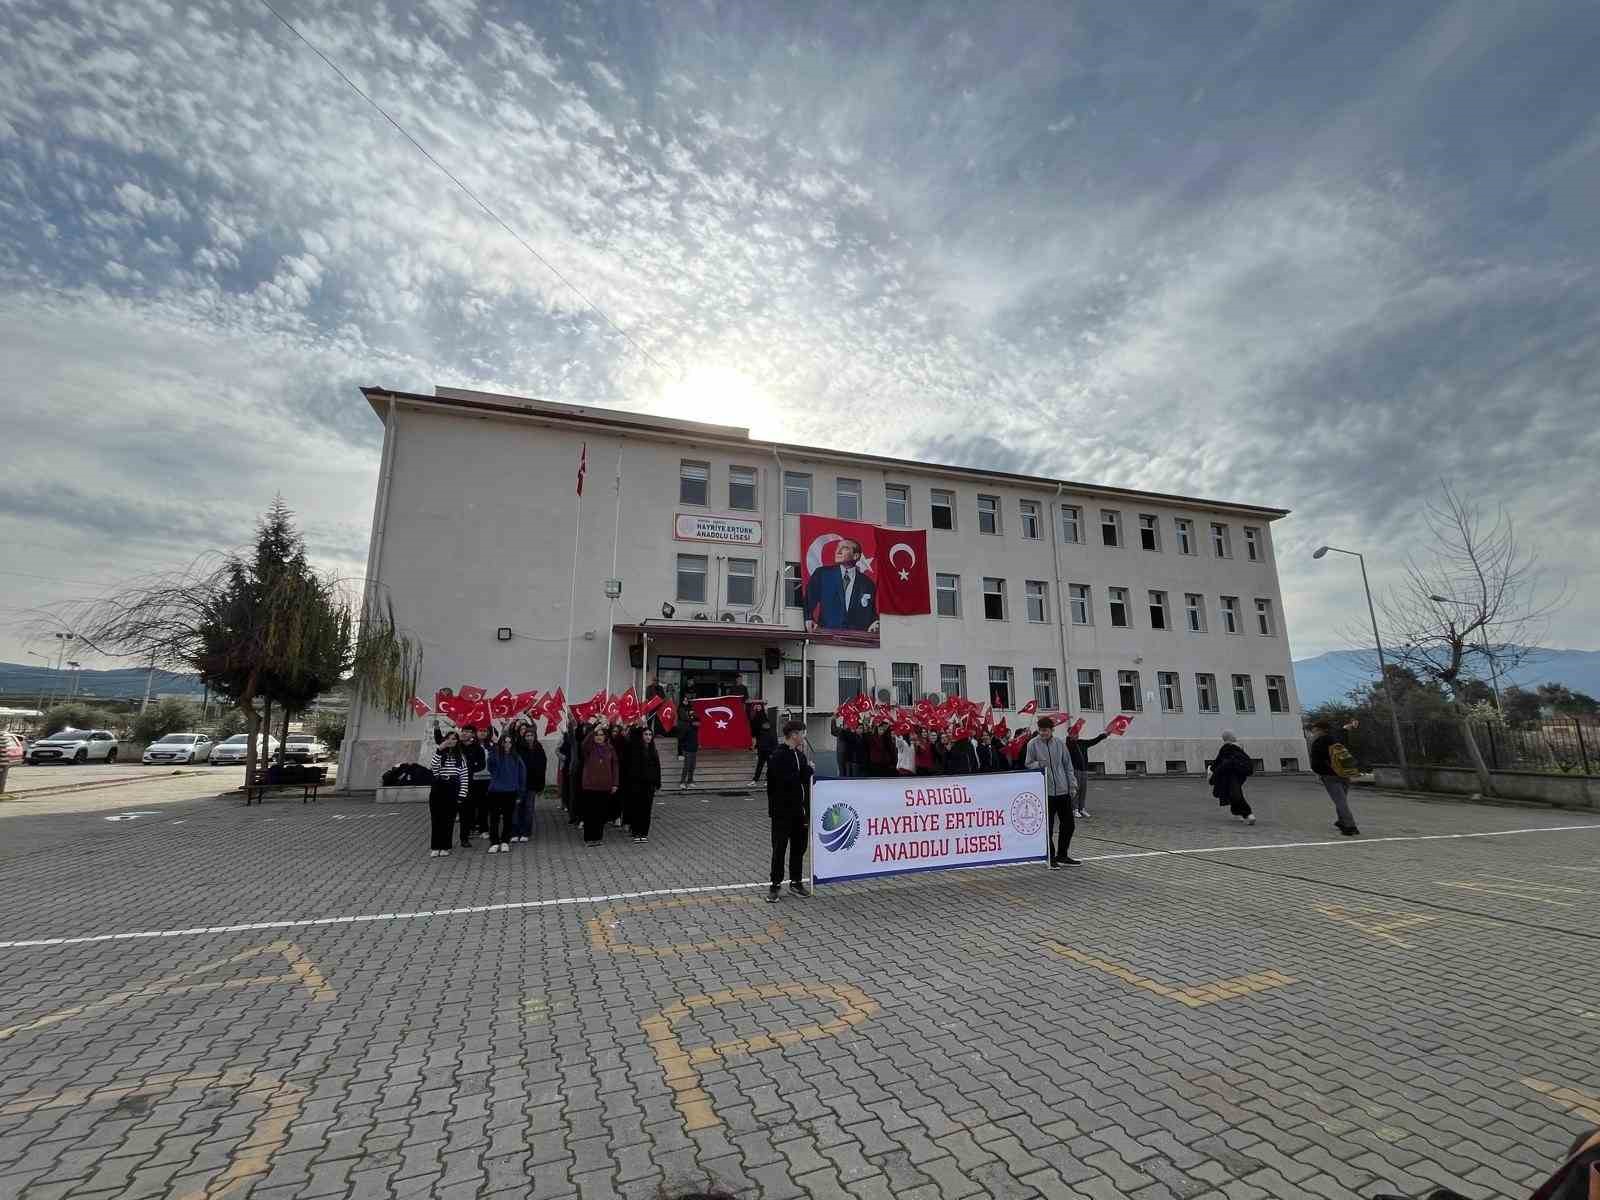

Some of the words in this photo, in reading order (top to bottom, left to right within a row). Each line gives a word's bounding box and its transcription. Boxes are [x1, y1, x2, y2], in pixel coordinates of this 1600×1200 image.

[697, 531, 728, 539] ANADOLU
[904, 784, 972, 807] SARIGÖL
[867, 811, 940, 836] HAYRİYE
[945, 807, 1005, 830] ERTÜRK
[872, 838, 949, 863] ANADOLU
[956, 830, 1003, 854] LİSESİ
